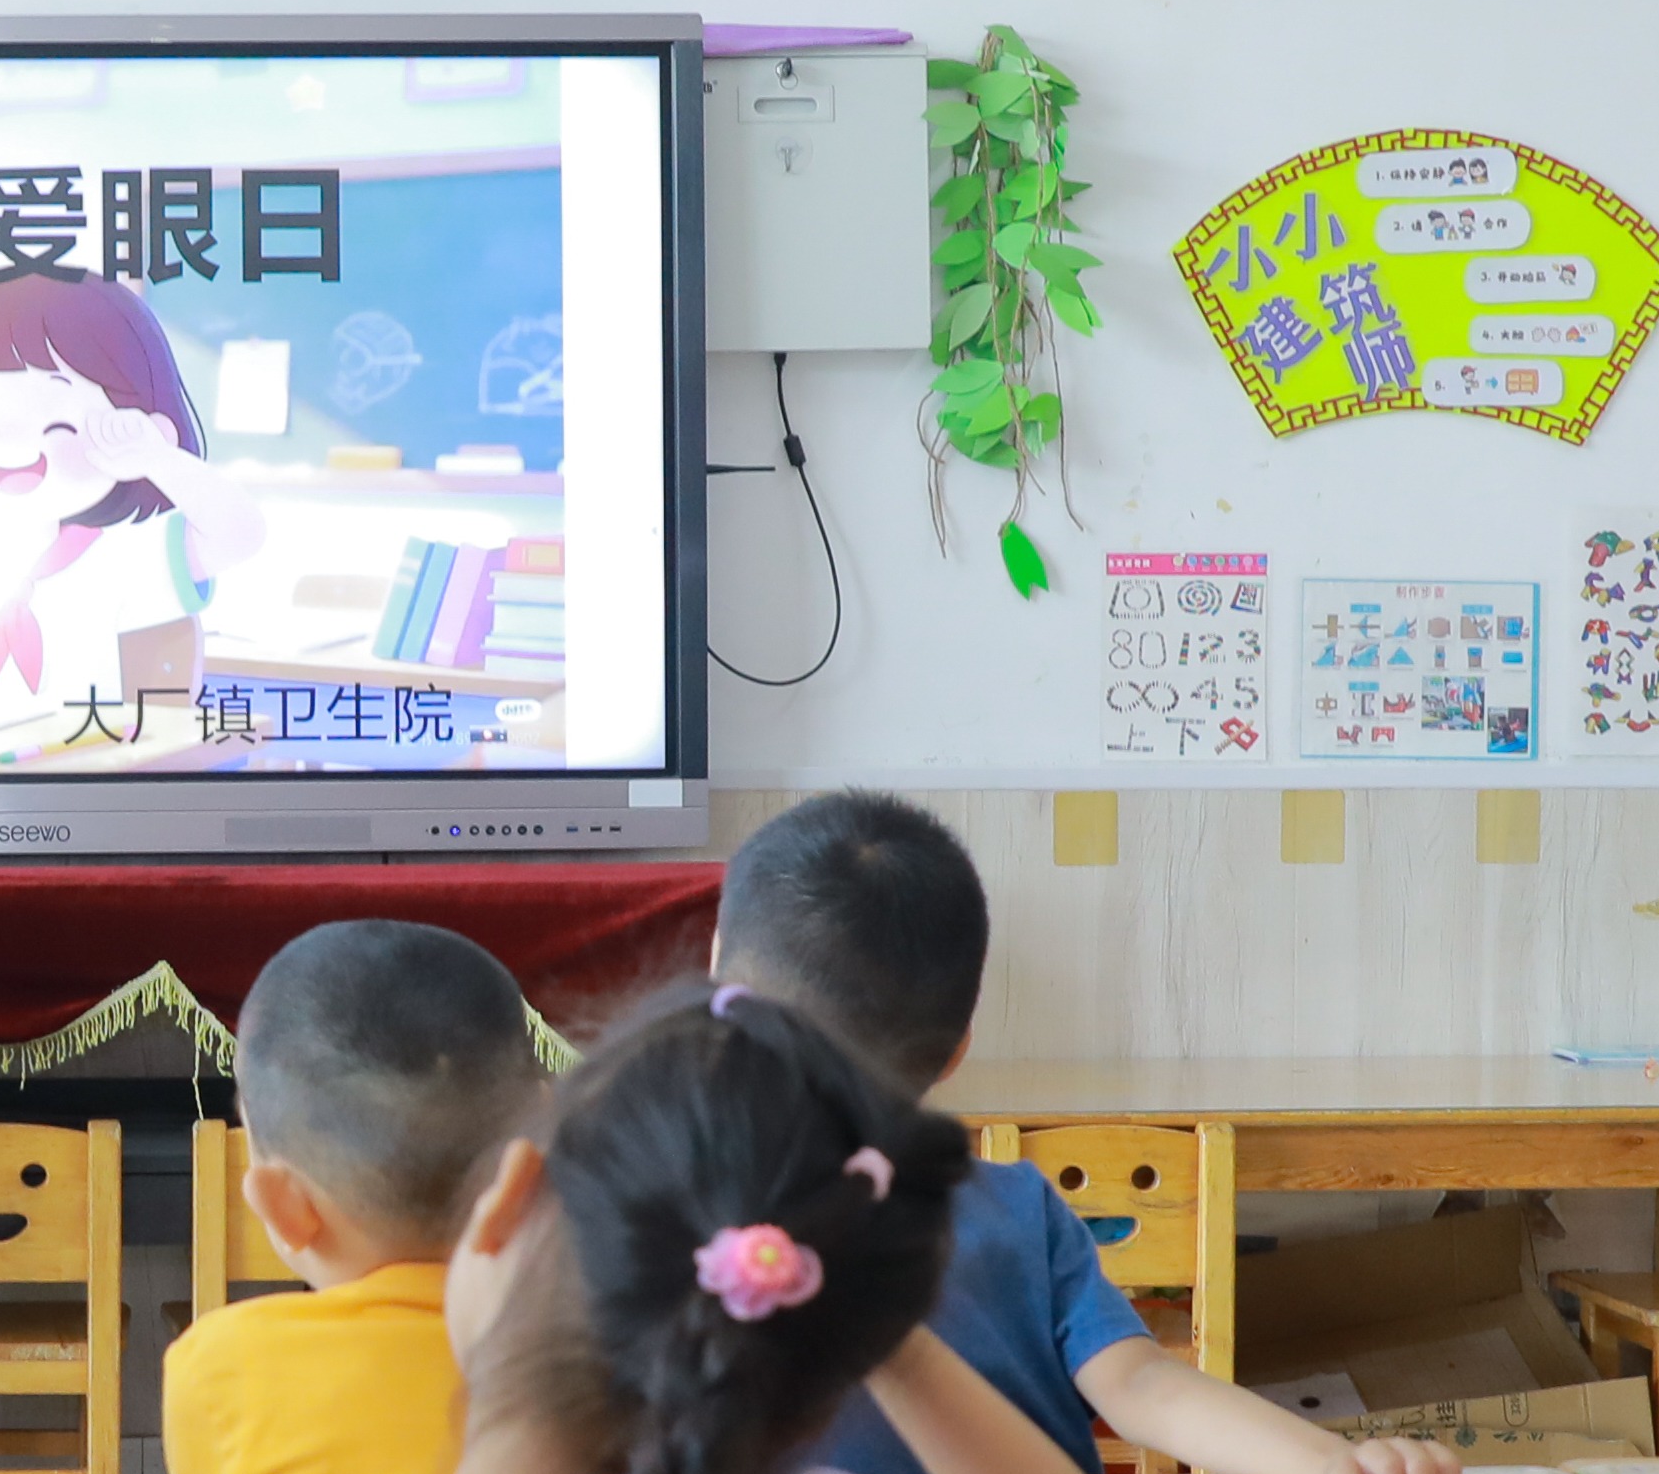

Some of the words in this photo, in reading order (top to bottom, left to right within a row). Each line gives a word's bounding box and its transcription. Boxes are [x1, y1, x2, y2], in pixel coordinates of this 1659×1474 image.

[63, 682, 454, 745] 大厂镇卫生院
